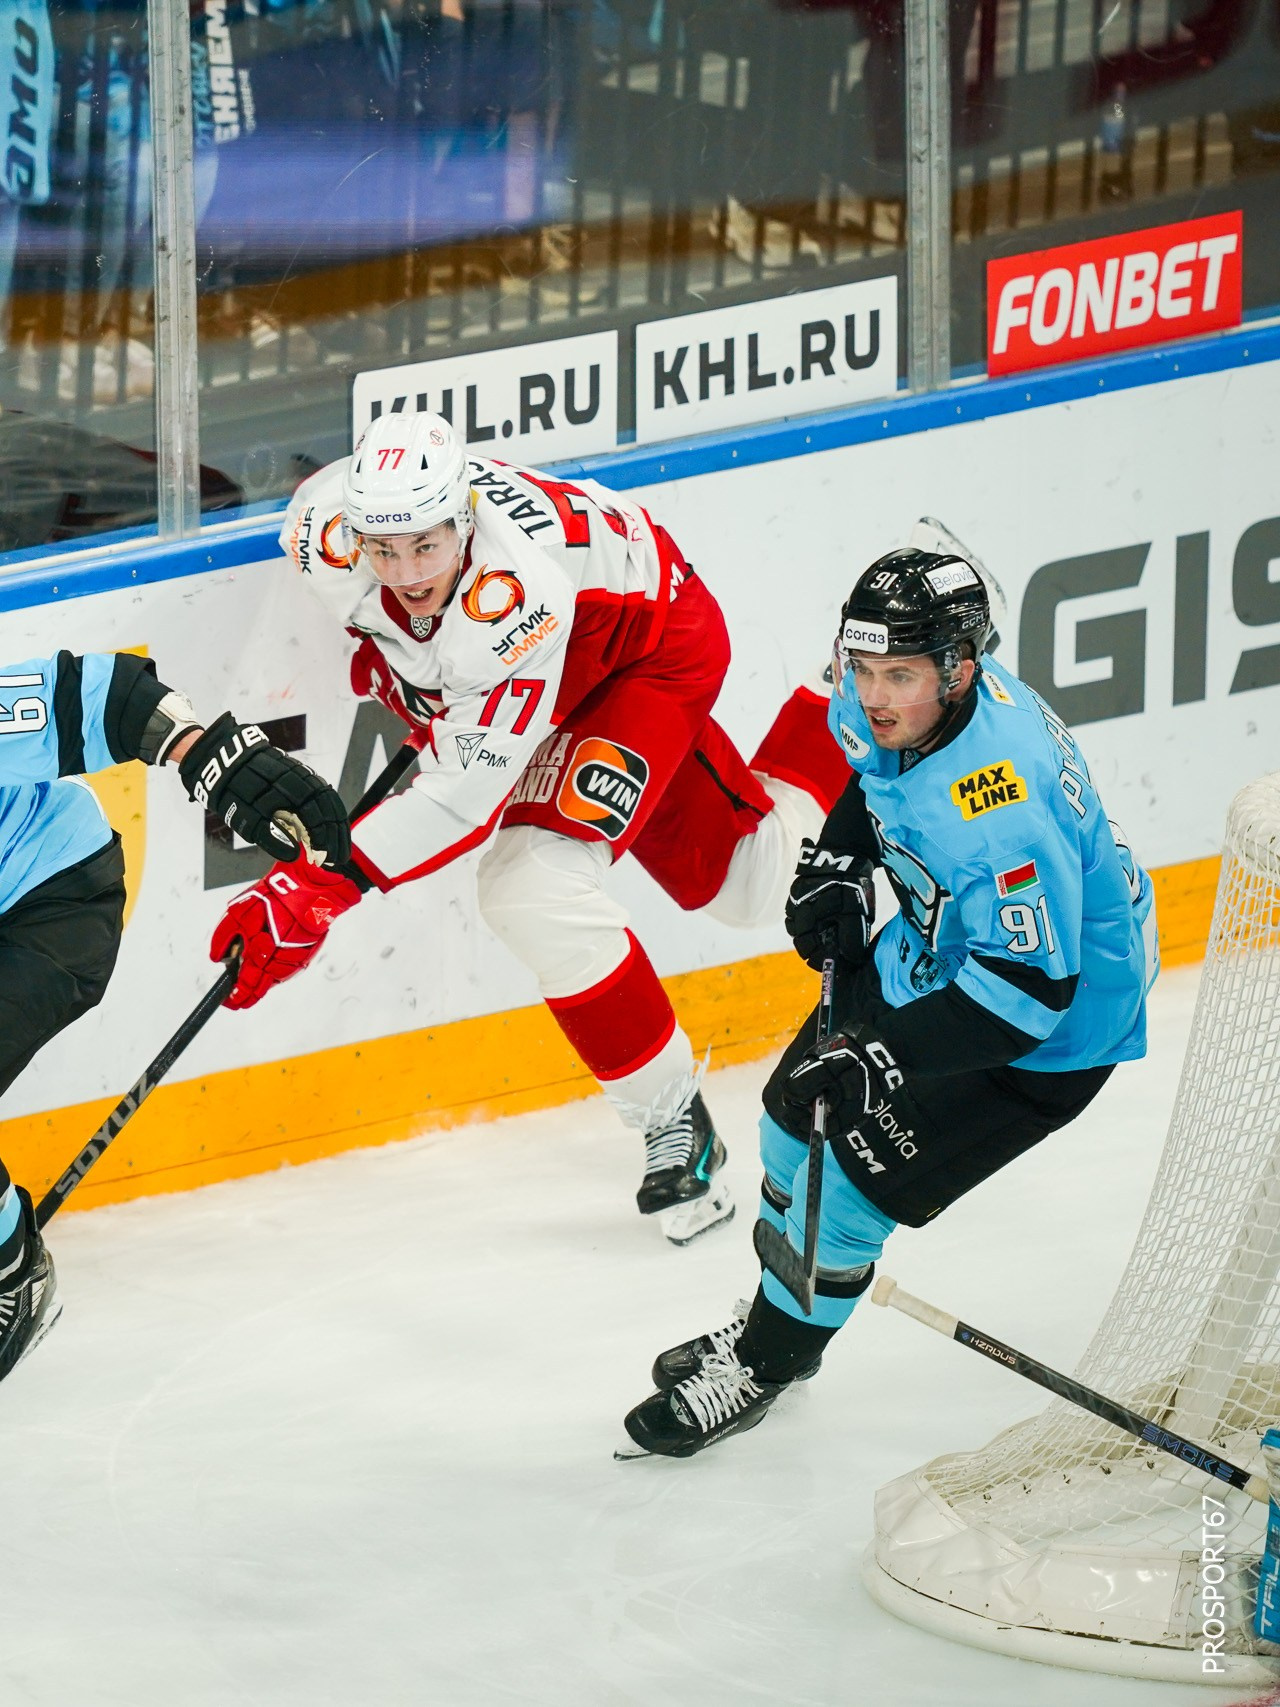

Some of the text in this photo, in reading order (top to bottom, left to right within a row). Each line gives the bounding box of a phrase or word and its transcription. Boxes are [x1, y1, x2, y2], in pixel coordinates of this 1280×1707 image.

[994, 232, 1238, 355] FONBET
[654, 309, 880, 409] KHL.RU
[377, 449, 405, 471] 77
[300, 506, 315, 575] УГМК
[365, 512, 412, 524] согаз
[871, 571, 899, 590] 91
[492, 604, 552, 656] УГМК
[502, 615, 559, 665] UMMC
[845, 628, 886, 644] согаз
[478, 678, 546, 736] 77
[841, 728, 859, 751] МИР
[587, 770, 637, 812] WIN
[958, 766, 1008, 799] MAX
[969, 783, 1020, 814] LINE
[998, 895, 1055, 954] 91
[55, 1072, 156, 1200] SOYUZ
